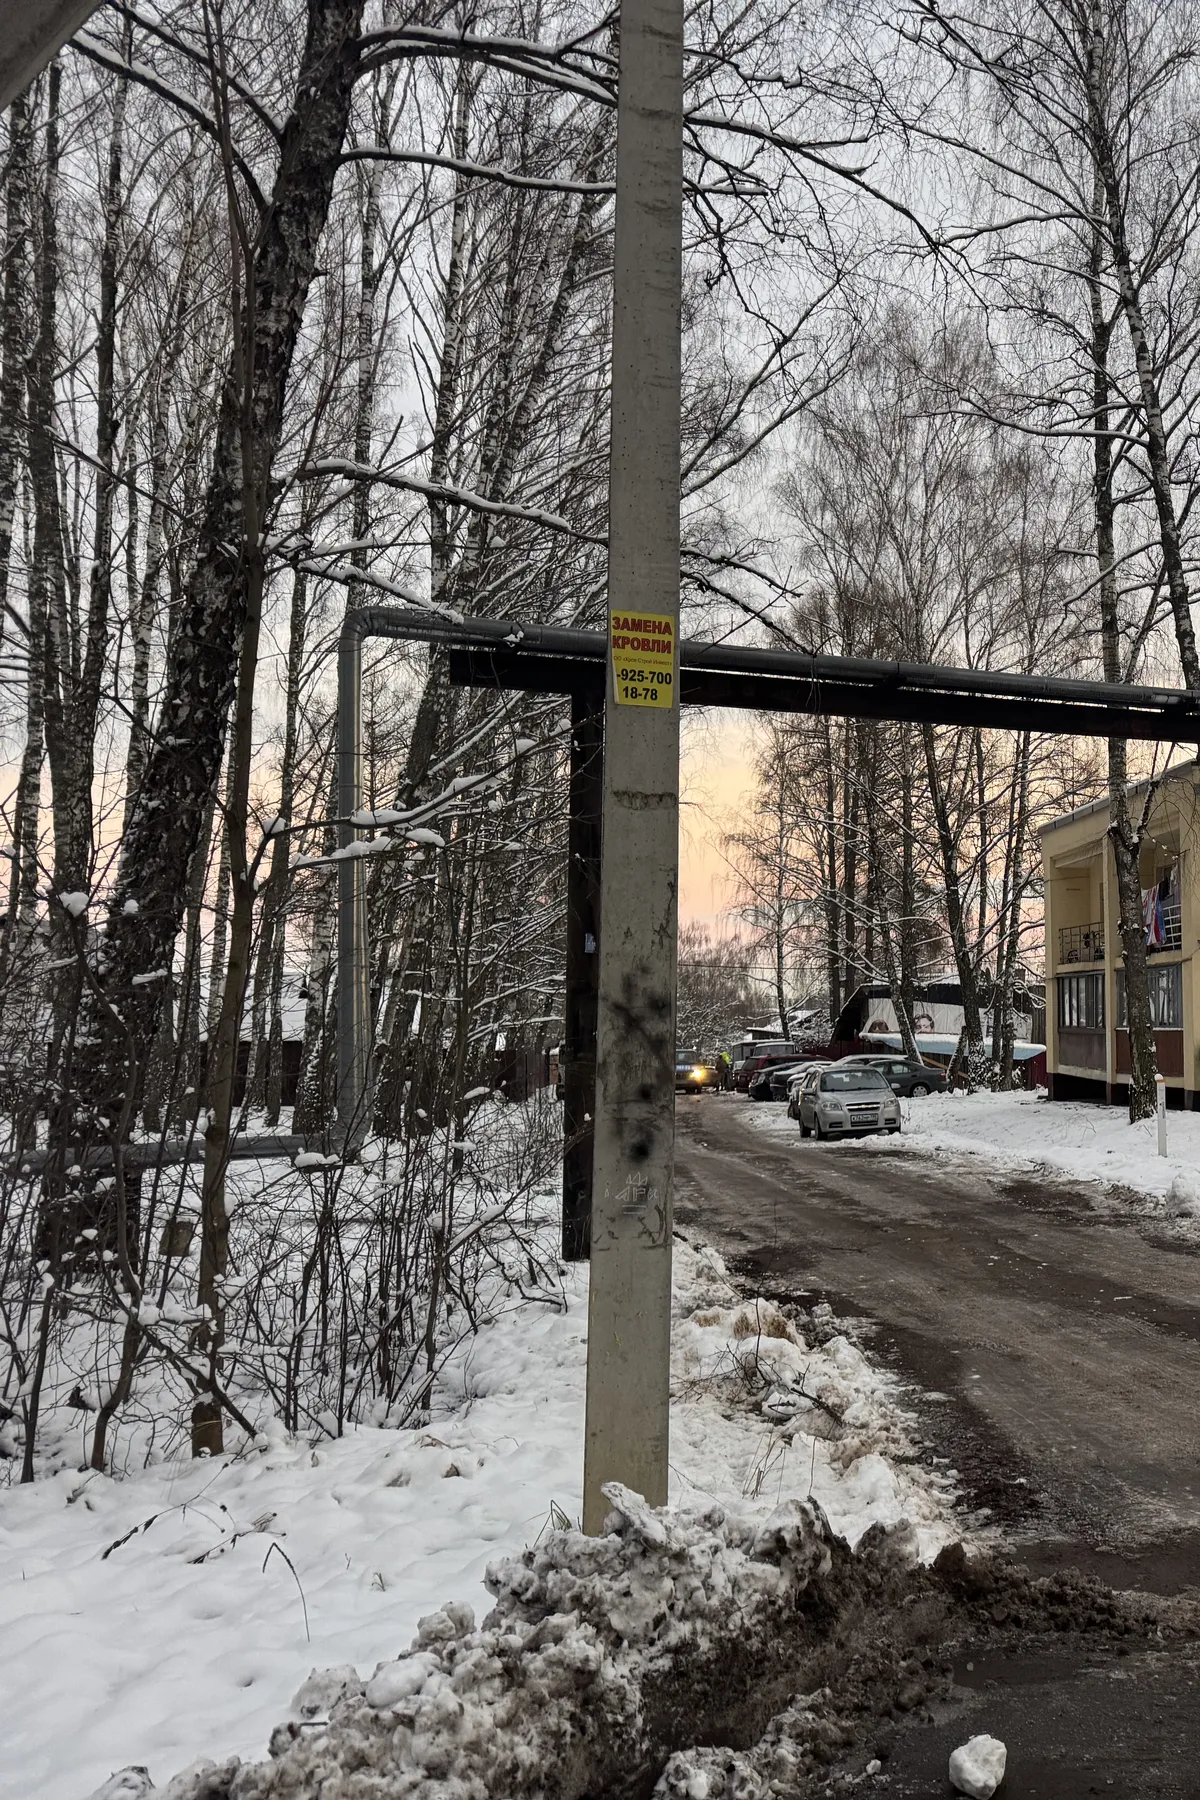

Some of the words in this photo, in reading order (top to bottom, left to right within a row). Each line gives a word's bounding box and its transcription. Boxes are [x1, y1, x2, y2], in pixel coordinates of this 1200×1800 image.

[612, 616, 672, 635] ЗАМЕНА
[612, 635, 672, 654] КРОВЛИ
[622, 685, 658, 701] 18-78
